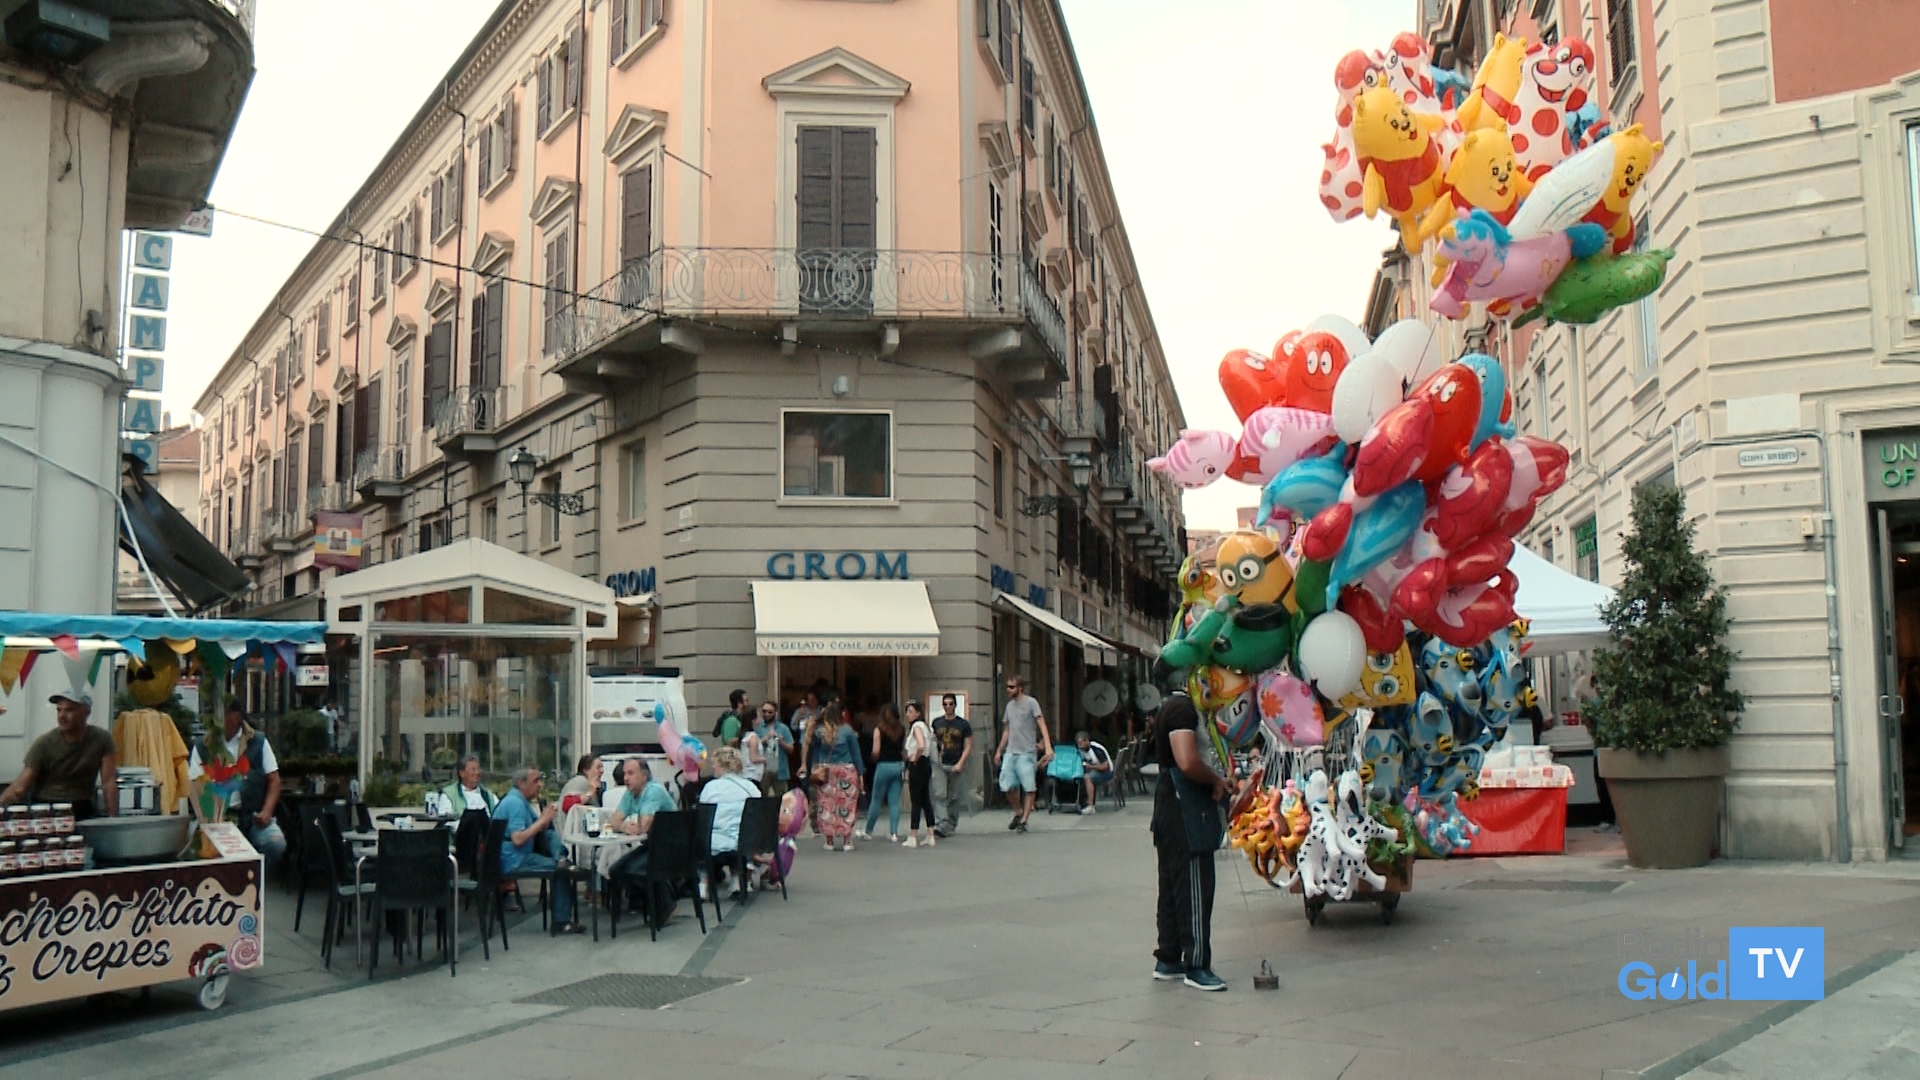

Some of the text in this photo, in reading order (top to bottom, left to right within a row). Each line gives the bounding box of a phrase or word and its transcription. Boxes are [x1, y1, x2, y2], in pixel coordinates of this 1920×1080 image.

[1882, 467, 1915, 487] OF
[767, 550, 909, 580] GROM
[767, 640, 930, 651] IL GELATO COME UNA VOLTA
[132, 880, 246, 937] filato
[33, 939, 173, 980] Crepes
